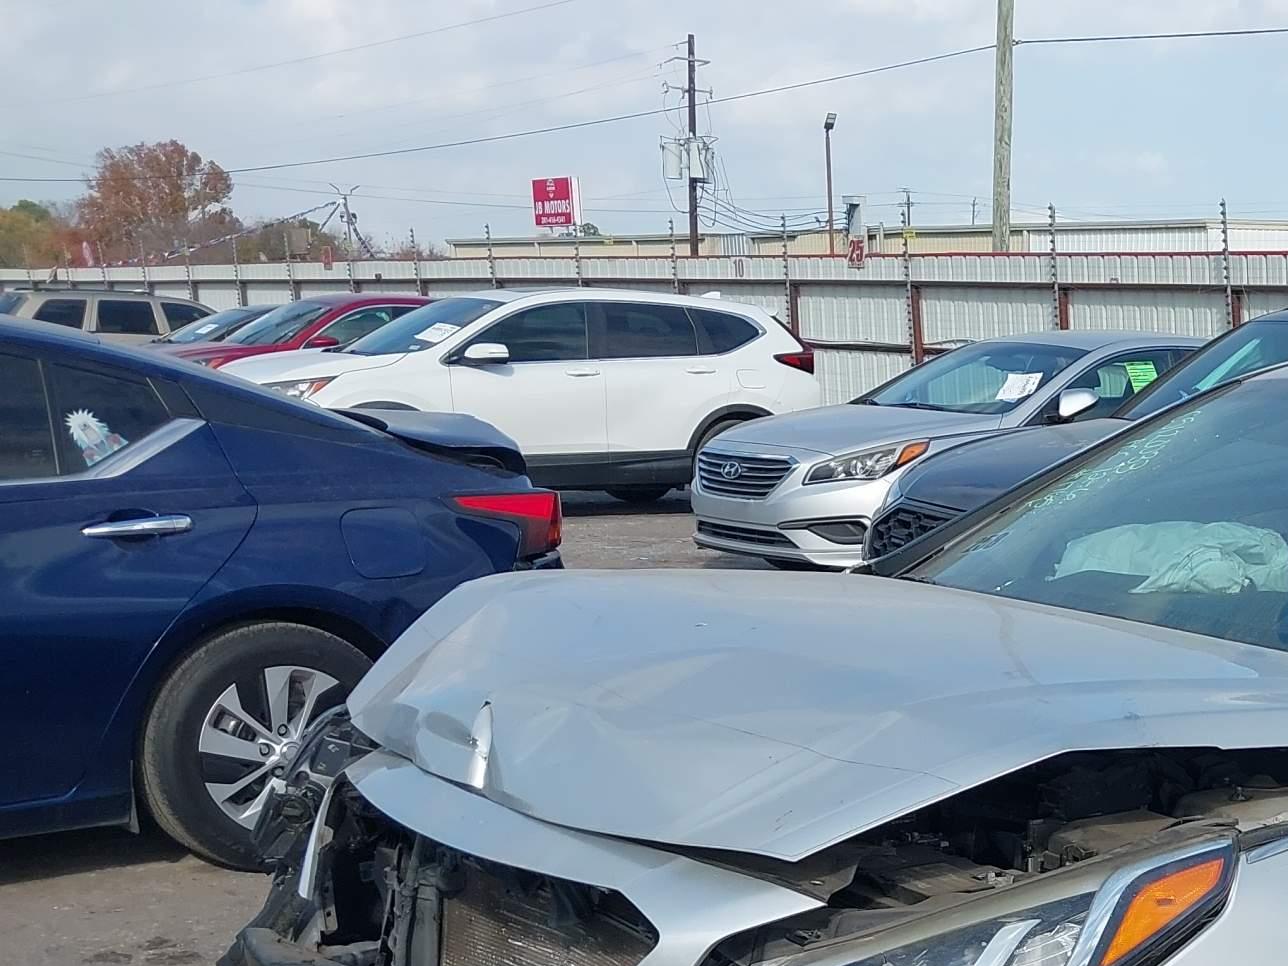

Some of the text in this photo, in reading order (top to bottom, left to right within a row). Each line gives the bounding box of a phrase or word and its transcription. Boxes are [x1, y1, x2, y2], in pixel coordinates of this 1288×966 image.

[535, 199, 571, 214] JB MOTORS
[848, 239, 865, 263] 25
[733, 258, 744, 278] 10
